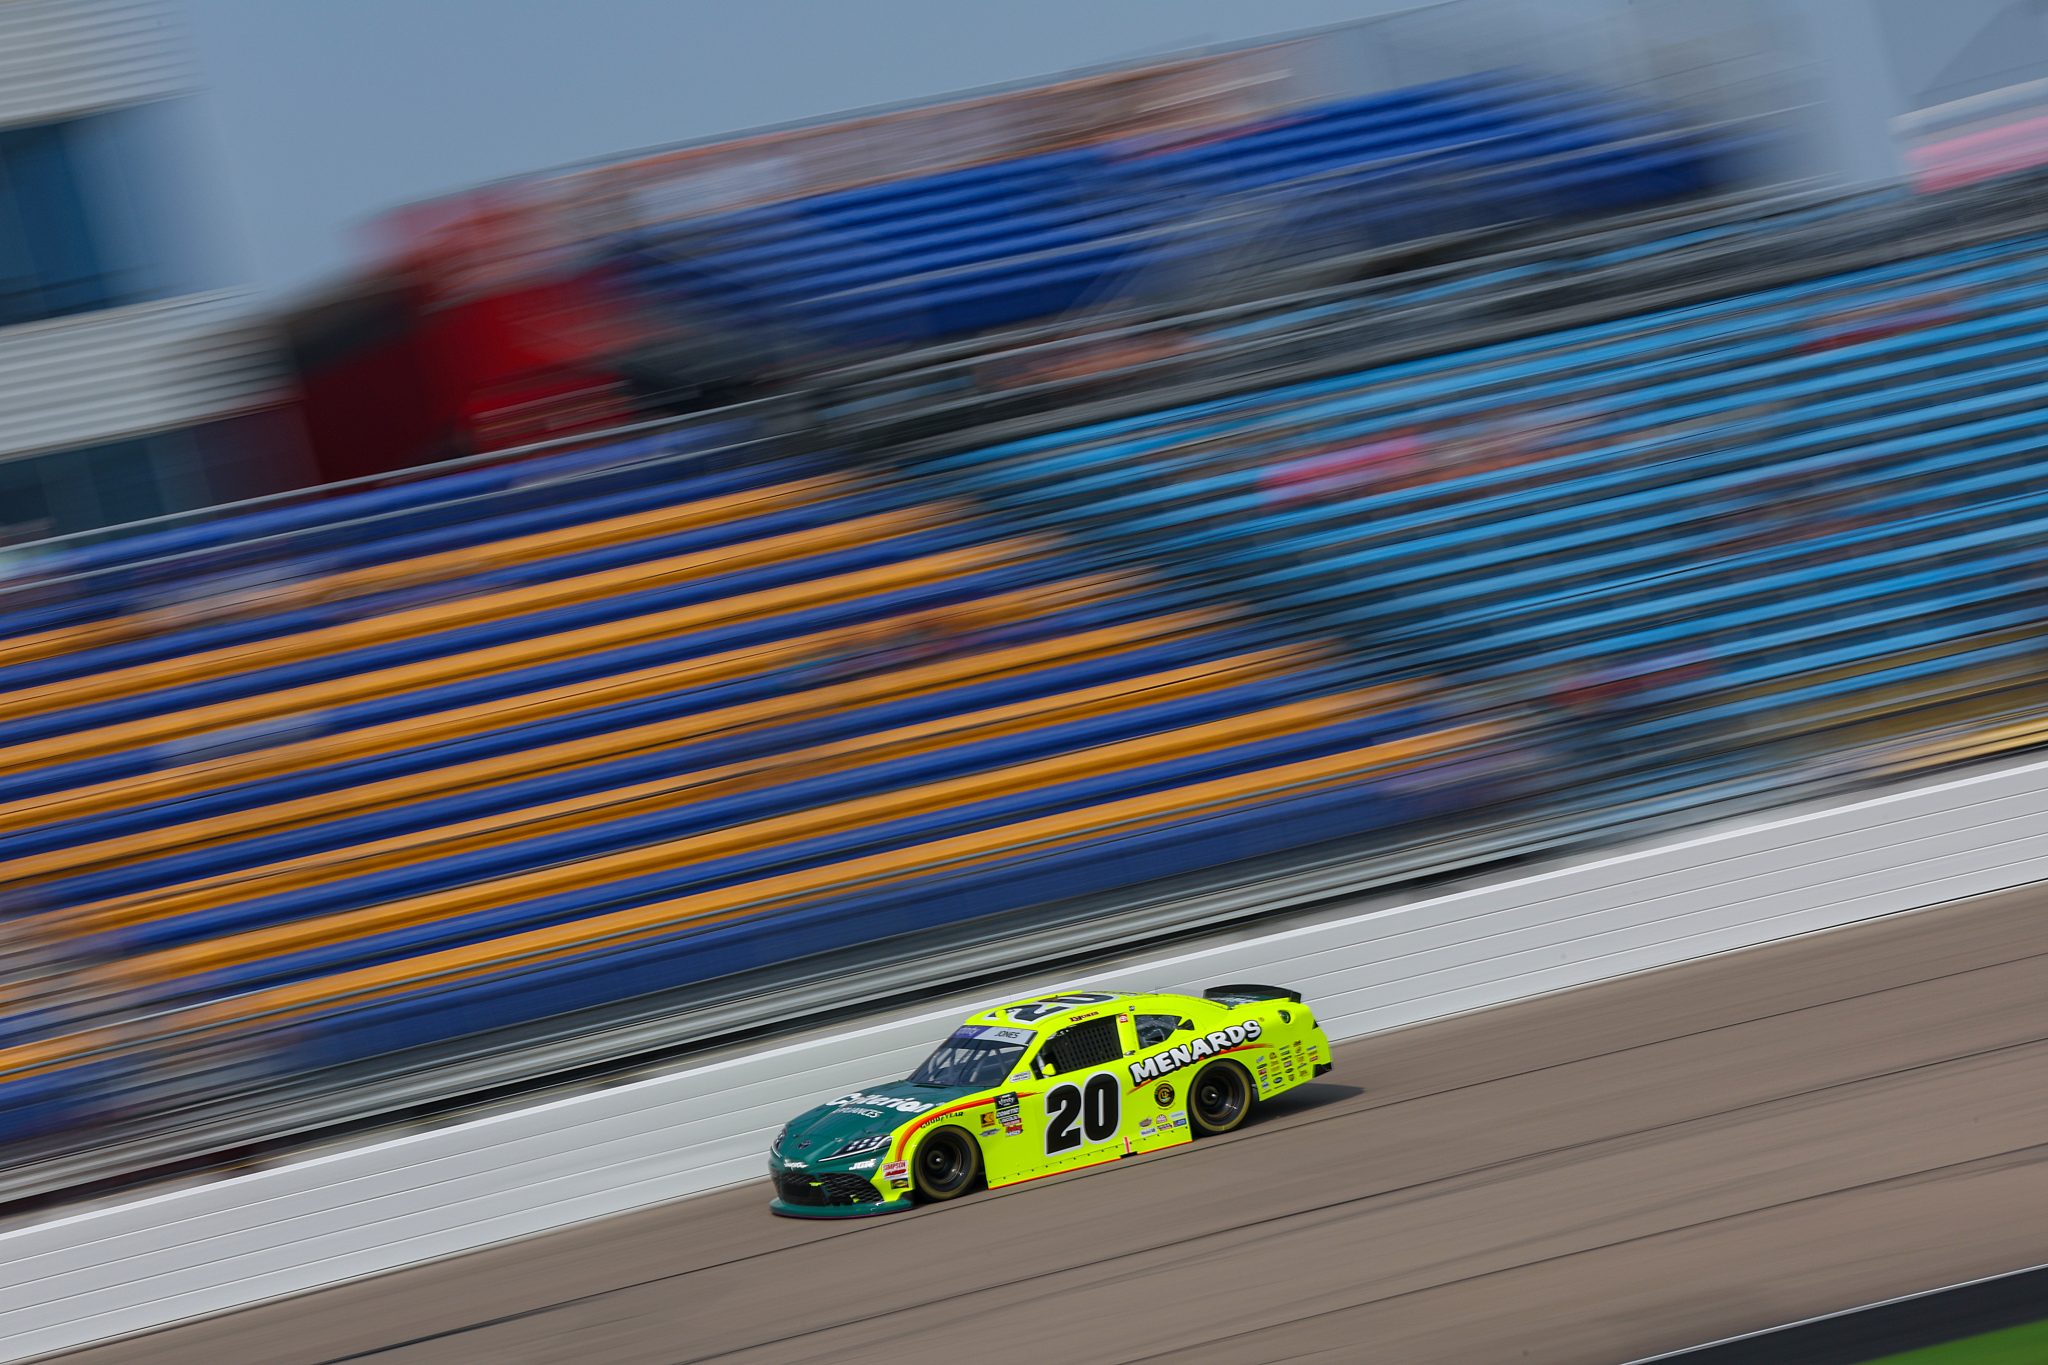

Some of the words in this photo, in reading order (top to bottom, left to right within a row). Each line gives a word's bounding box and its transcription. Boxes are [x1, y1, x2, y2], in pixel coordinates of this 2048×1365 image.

[994, 1030, 1020, 1039] JONES
[1129, 1020, 1263, 1087] MENARDS
[920, 1111, 964, 1129] GOODYEAR
[1044, 1071, 1121, 1157] 20
[882, 1160, 906, 1171] SIMPSON
